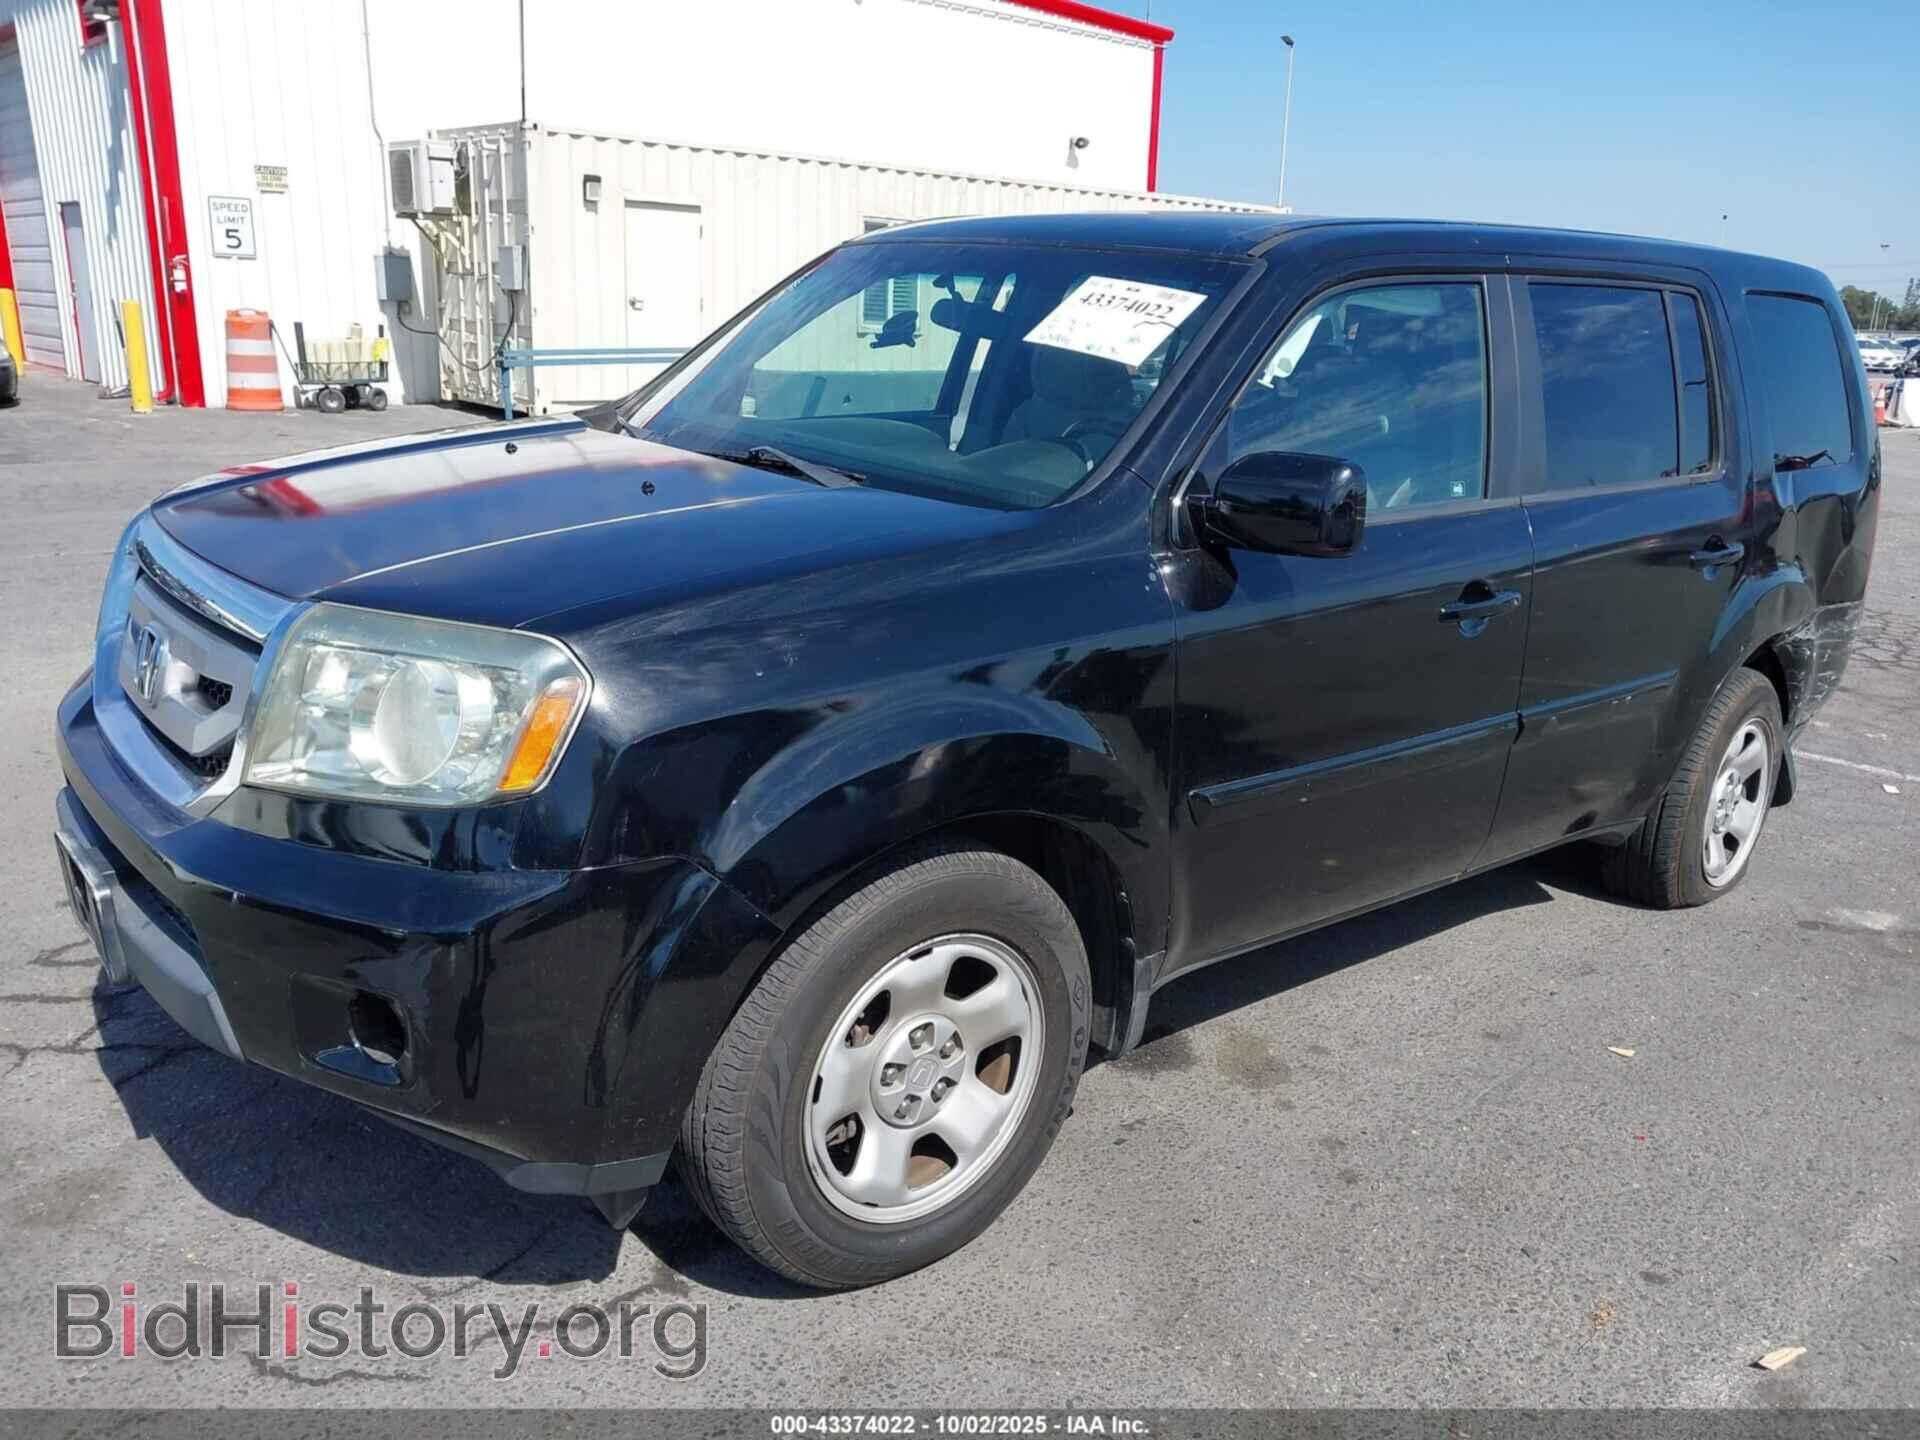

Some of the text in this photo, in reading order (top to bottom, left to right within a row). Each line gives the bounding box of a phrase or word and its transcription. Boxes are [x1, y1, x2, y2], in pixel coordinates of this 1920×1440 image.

[212, 202, 248, 213] SPEED
[217, 216, 245, 224] LIMIT
[225, 228, 242, 249] 5
[1080, 292, 1174, 319] 43374022
